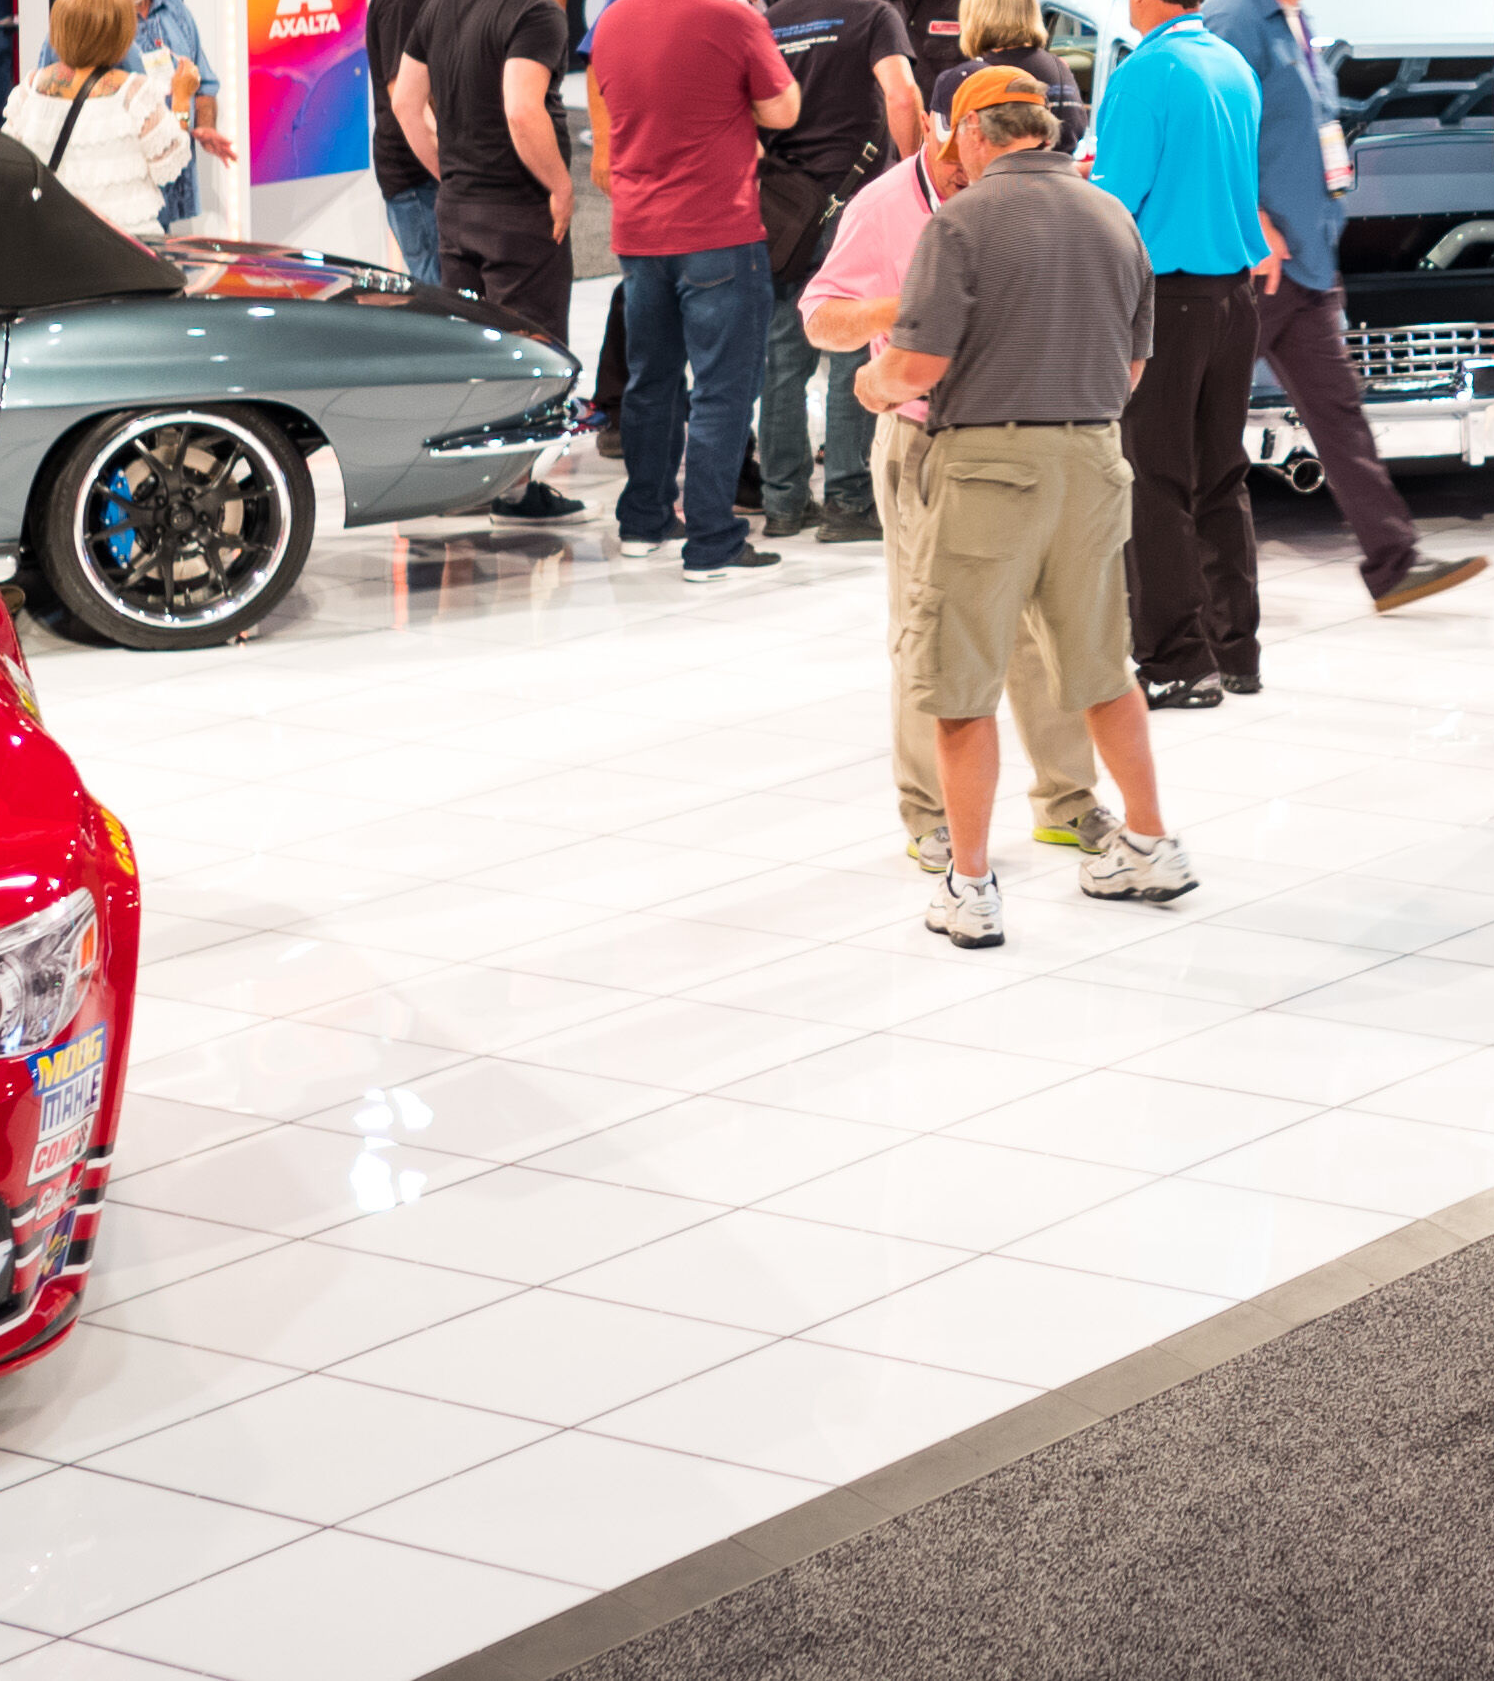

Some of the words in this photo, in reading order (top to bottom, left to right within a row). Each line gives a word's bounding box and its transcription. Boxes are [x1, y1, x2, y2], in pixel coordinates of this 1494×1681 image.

[268, 9, 341, 41] AXALTA
[37, 1026, 103, 1092] MOOG
[41, 1067, 101, 1132] MAHLE
